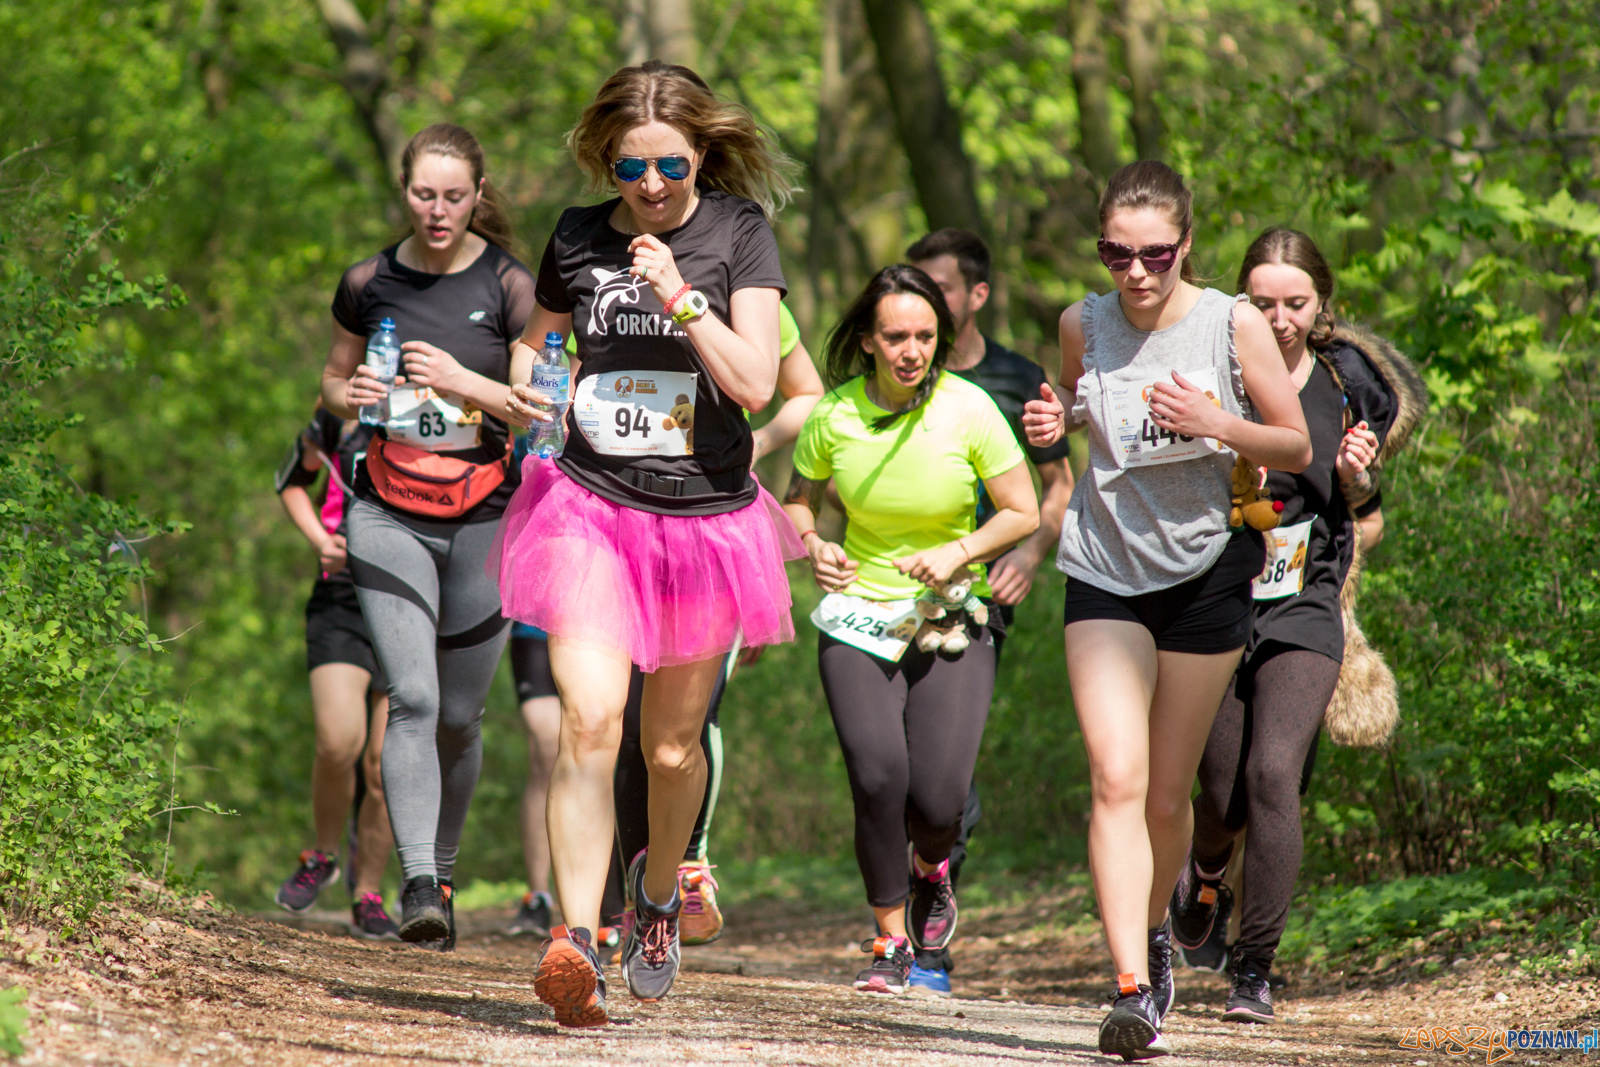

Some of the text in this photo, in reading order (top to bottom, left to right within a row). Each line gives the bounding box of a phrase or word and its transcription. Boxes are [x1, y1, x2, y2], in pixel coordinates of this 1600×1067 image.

[616, 313, 660, 336] ORKI
[418, 411, 446, 437] 63
[615, 407, 651, 438] 94
[385, 478, 433, 503] Reebok
[841, 612, 888, 638] 425
